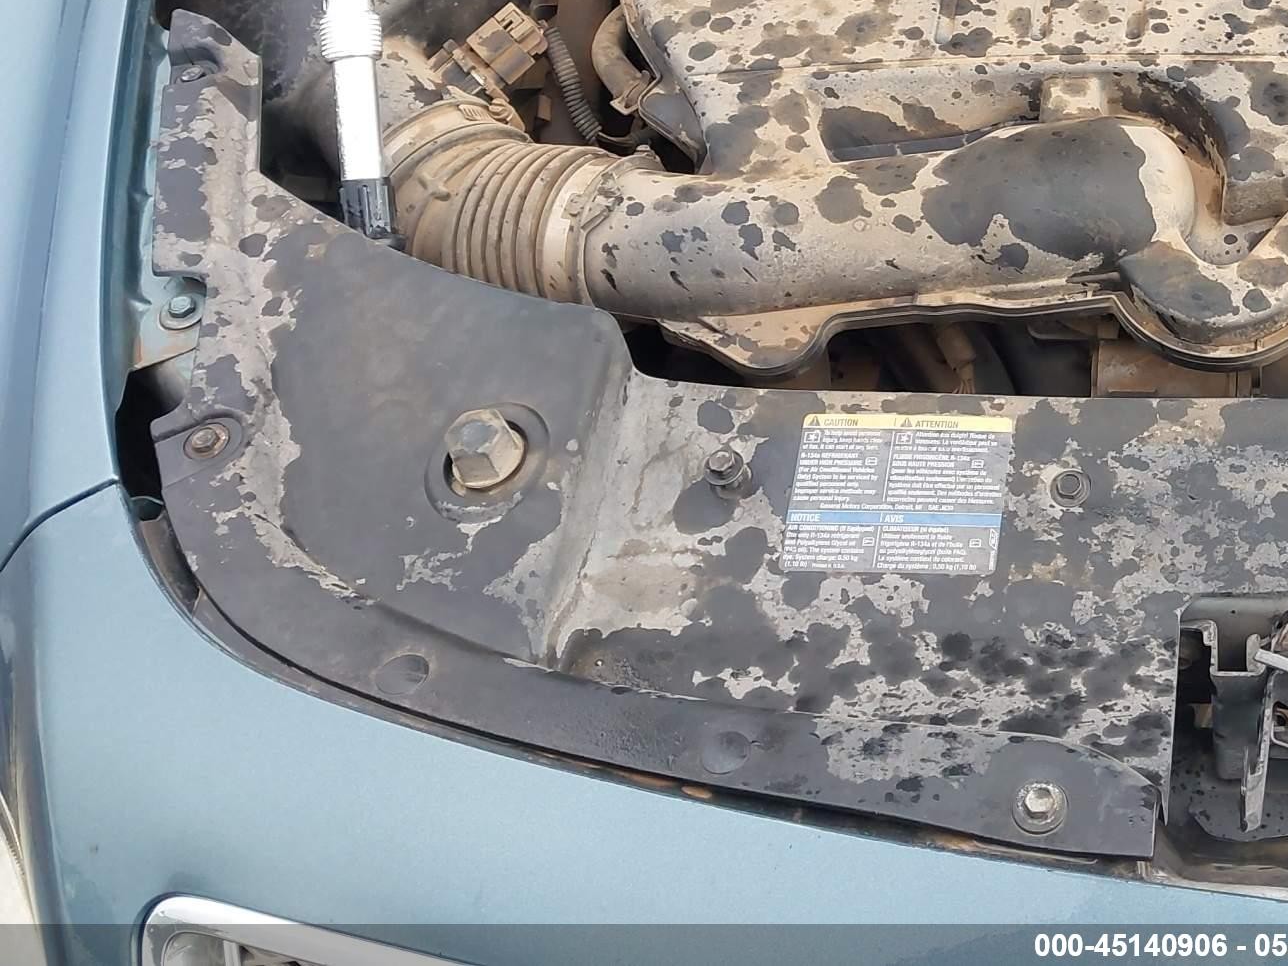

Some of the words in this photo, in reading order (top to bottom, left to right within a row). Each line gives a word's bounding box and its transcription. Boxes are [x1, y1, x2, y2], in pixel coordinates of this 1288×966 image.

[824, 418, 859, 427] CAUTION
[915, 420, 959, 429] ATTENTION
[790, 513, 821, 522] NOTICE
[884, 515, 904, 523] AVIS
